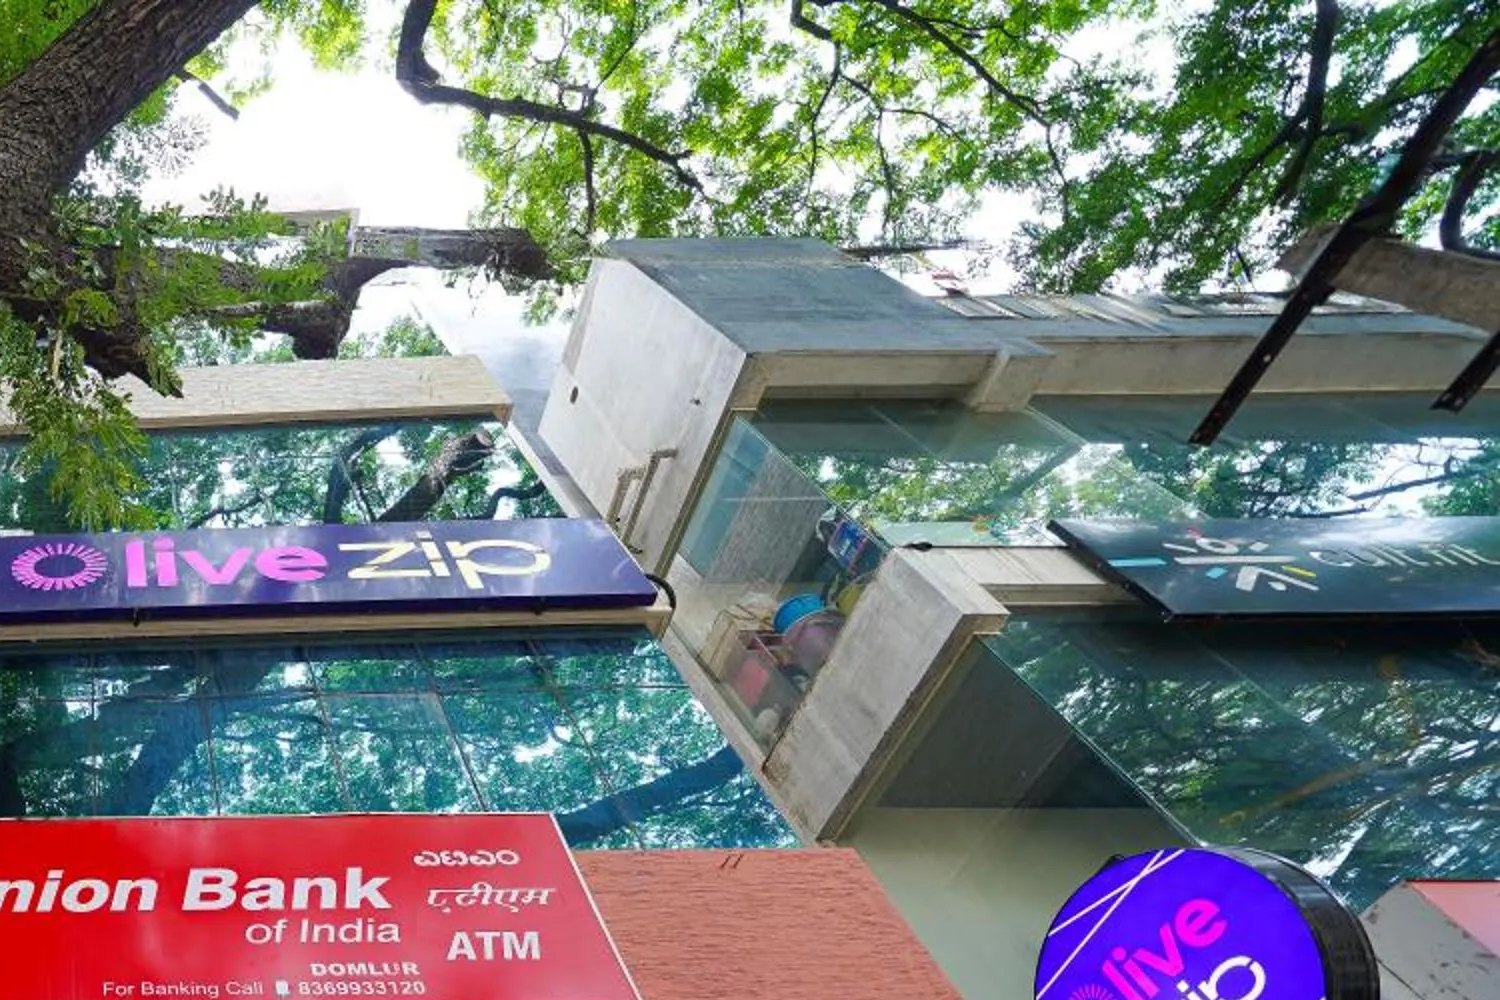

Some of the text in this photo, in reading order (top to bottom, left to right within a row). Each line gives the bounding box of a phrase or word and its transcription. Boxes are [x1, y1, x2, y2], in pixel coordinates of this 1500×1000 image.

[338, 531, 551, 590] zip
[182, 867, 392, 912] Bank
[244, 917, 402, 944] of India
[446, 931, 541, 960] ATM
[309, 962, 421, 976] DOMLUR
[102, 980, 134, 996] For
[141, 980, 221, 998] Banking
